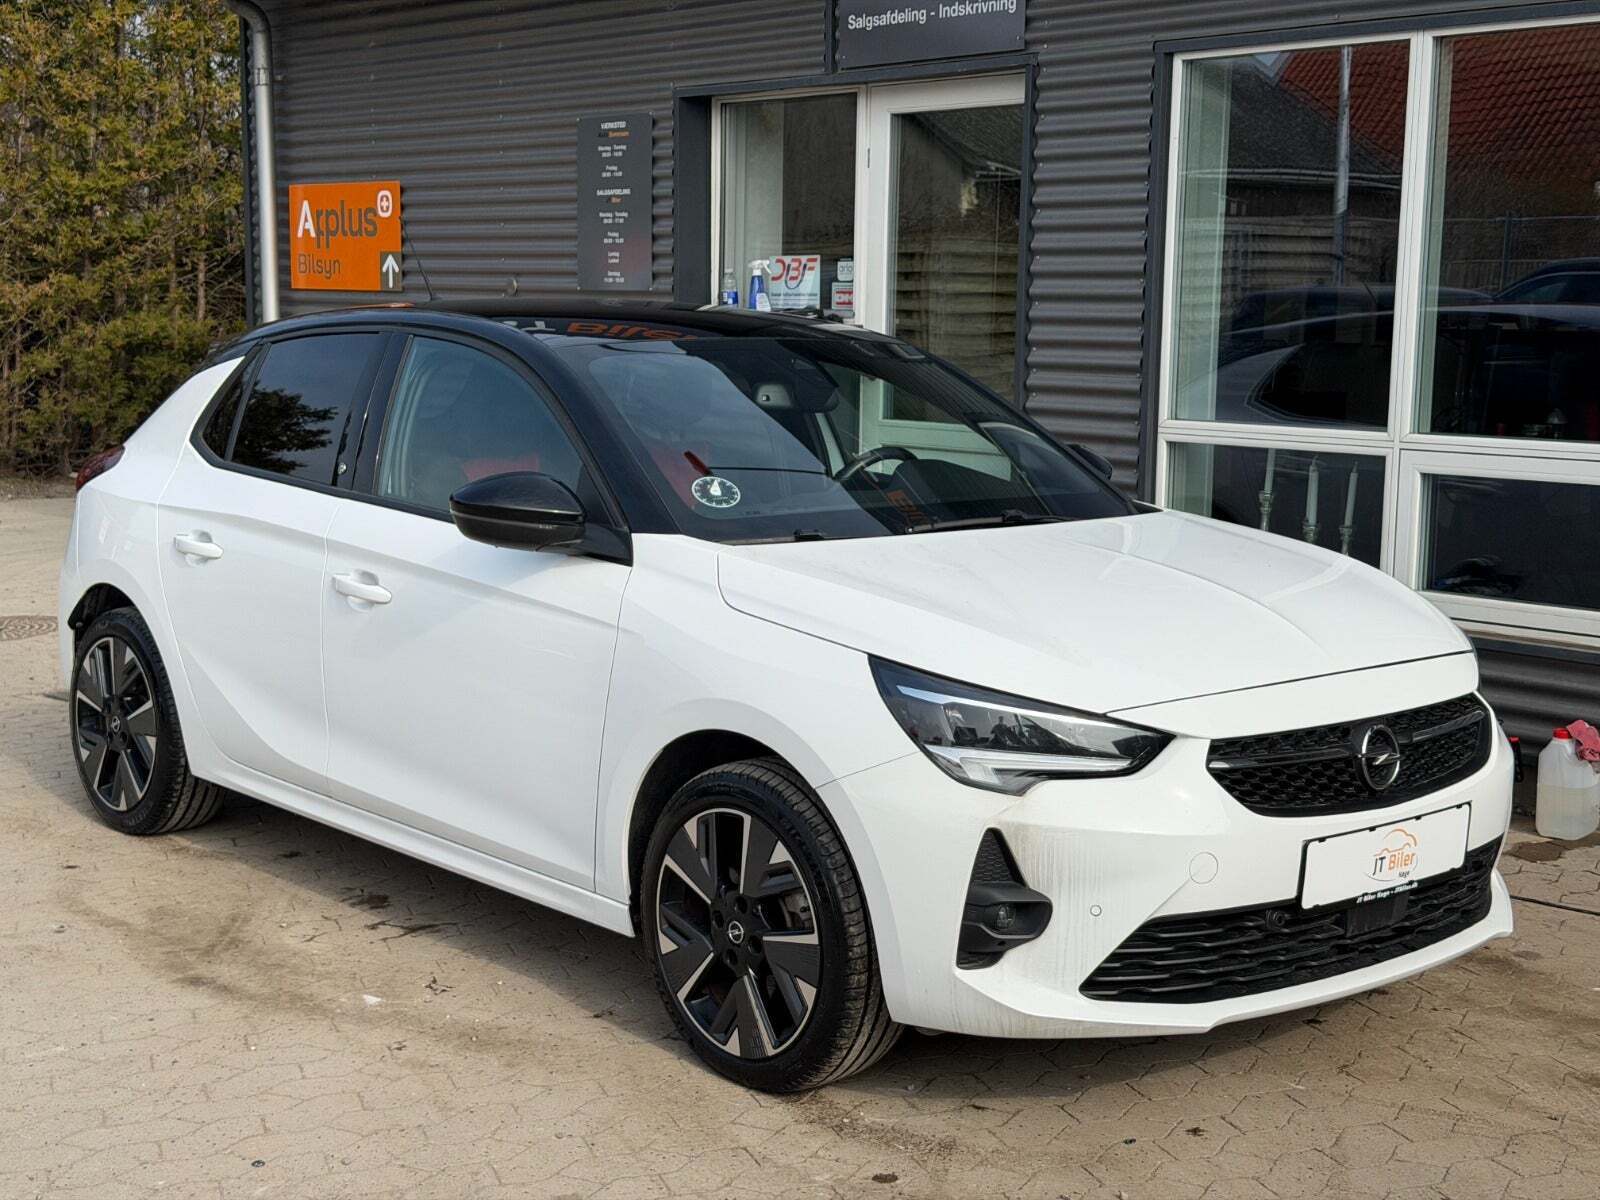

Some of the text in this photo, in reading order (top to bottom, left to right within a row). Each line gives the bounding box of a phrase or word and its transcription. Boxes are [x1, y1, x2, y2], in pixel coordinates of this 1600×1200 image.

[847, 8, 927, 31] Salgsafdeling
[938, 0, 1017, 19] Indskrivning
[298, 253, 341, 280] Bilsyn
[1372, 852, 1416, 877] JT Biler
